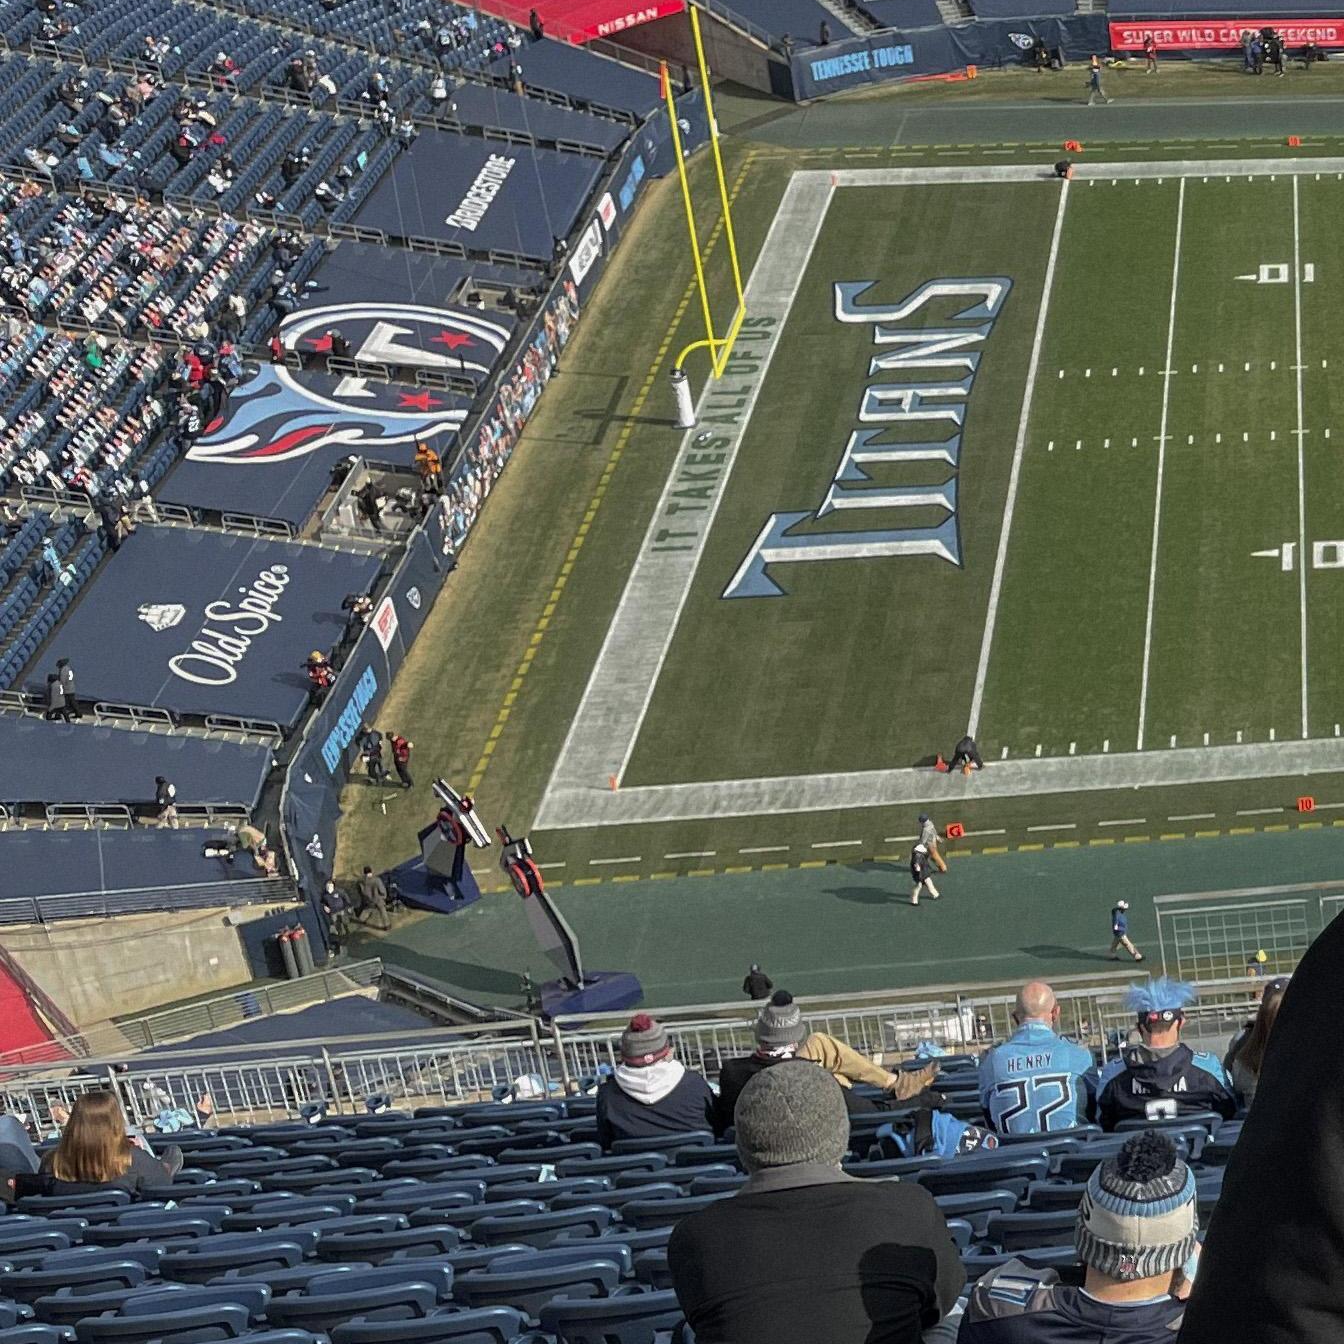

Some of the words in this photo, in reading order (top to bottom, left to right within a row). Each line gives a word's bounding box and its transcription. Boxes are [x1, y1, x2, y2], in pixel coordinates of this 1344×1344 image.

[598, 7, 658, 36] NISSAN
[1122, 29, 1174, 44] SUPER
[1178, 28, 1215, 42] WILD
[1265, 27, 1337, 42] EEKEND
[810, 50, 871, 81] TENNESSEE
[872, 45, 914, 69] TOUGH
[445, 153, 516, 232] BRIDGESTONE
[1257, 262, 1314, 283] 10
[736, 316, 776, 342] US
[725, 350, 763, 375] OF
[702, 384, 752, 425] ALL
[720, 276, 1014, 599] TITANS
[665, 435, 731, 516] TAKES
[651, 528, 698, 553] IT
[204, 569, 290, 635] Spice
[168, 628, 252, 686] Old
[1301, 799, 1311, 810] 10
[949, 826, 961, 837] G
[1007, 1052, 1053, 1073] HENRY
